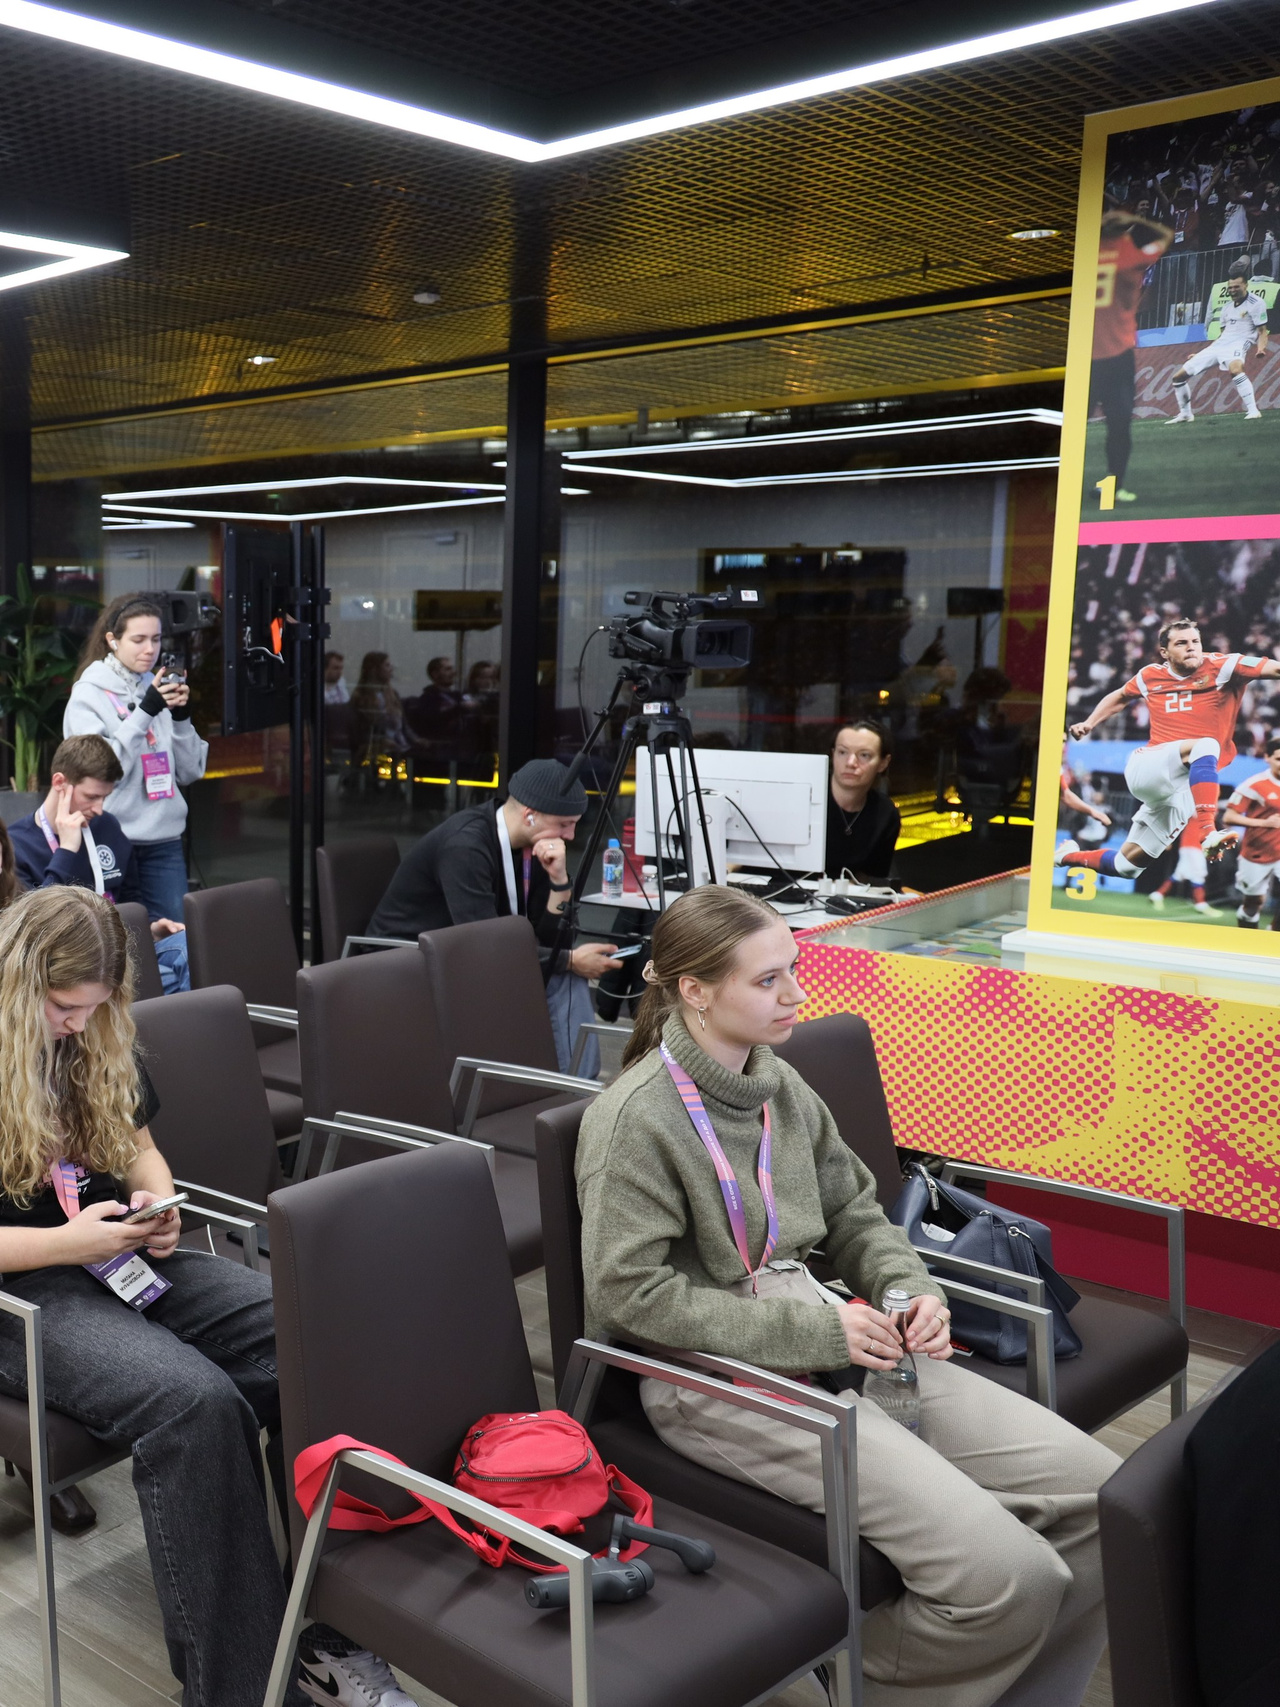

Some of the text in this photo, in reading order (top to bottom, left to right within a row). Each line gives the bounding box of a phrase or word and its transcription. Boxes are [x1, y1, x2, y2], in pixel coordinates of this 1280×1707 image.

[1095, 475, 1117, 511] 1
[1165, 690, 1193, 713] 22
[1065, 867, 1097, 900] 3
